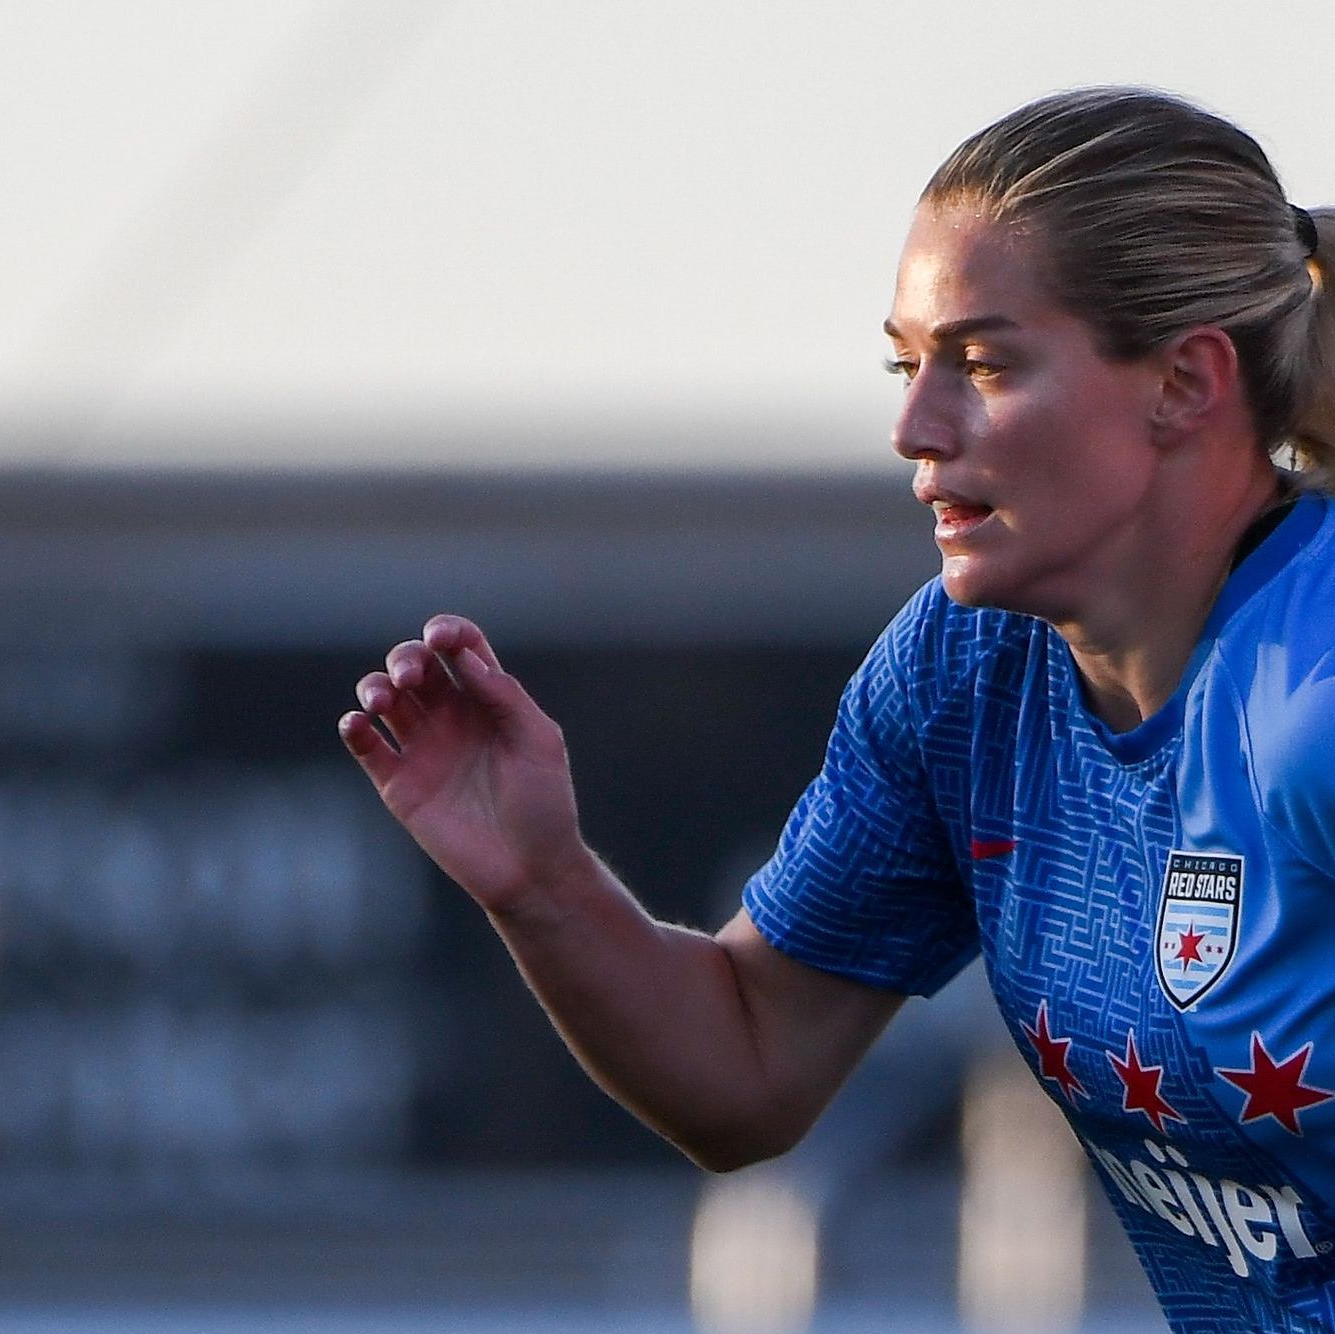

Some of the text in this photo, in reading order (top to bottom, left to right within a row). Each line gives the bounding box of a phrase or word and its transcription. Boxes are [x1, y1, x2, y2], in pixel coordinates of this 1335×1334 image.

[1173, 859, 1238, 873] CHICAGO
[1168, 871, 1237, 901] RED STARS
[1082, 1137, 1318, 1278] meijer
